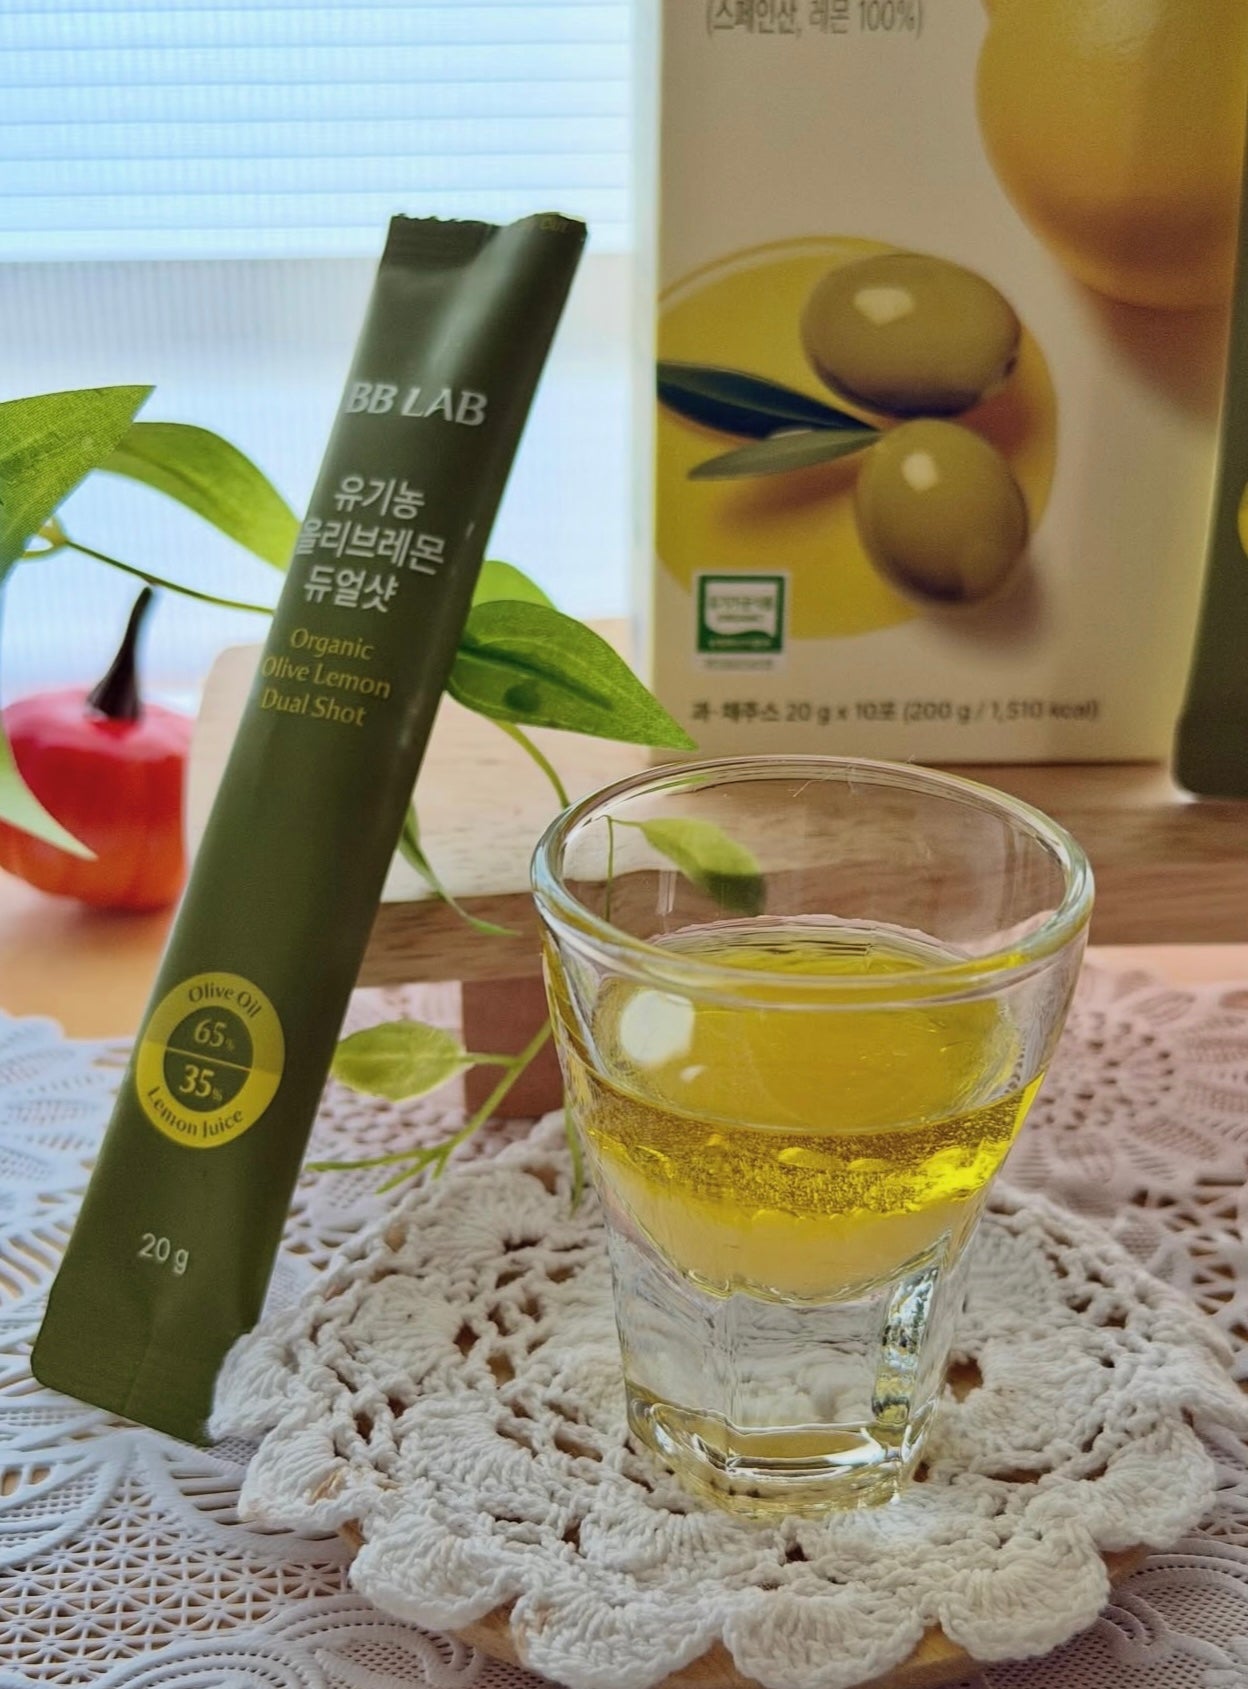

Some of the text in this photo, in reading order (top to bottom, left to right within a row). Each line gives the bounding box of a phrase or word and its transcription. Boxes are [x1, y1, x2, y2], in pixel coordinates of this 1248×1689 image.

[858, 0, 924, 40] 100%)
[345, 381, 488, 426] BB LAB
[334, 476, 425, 520] 유기농
[296, 516, 446, 576] 올리브레몬
[304, 564, 400, 613] 듀얼샷
[290, 627, 375, 660] Organic
[261, 655, 392, 699] Olive Lemon
[260, 686, 368, 727] Dual Shot
[903, 701, 951, 724] (200
[188, 982, 263, 1018] Olive Oil
[147, 1085, 244, 1139] Lemon Juice
[138, 1232, 190, 1276] 20 g
